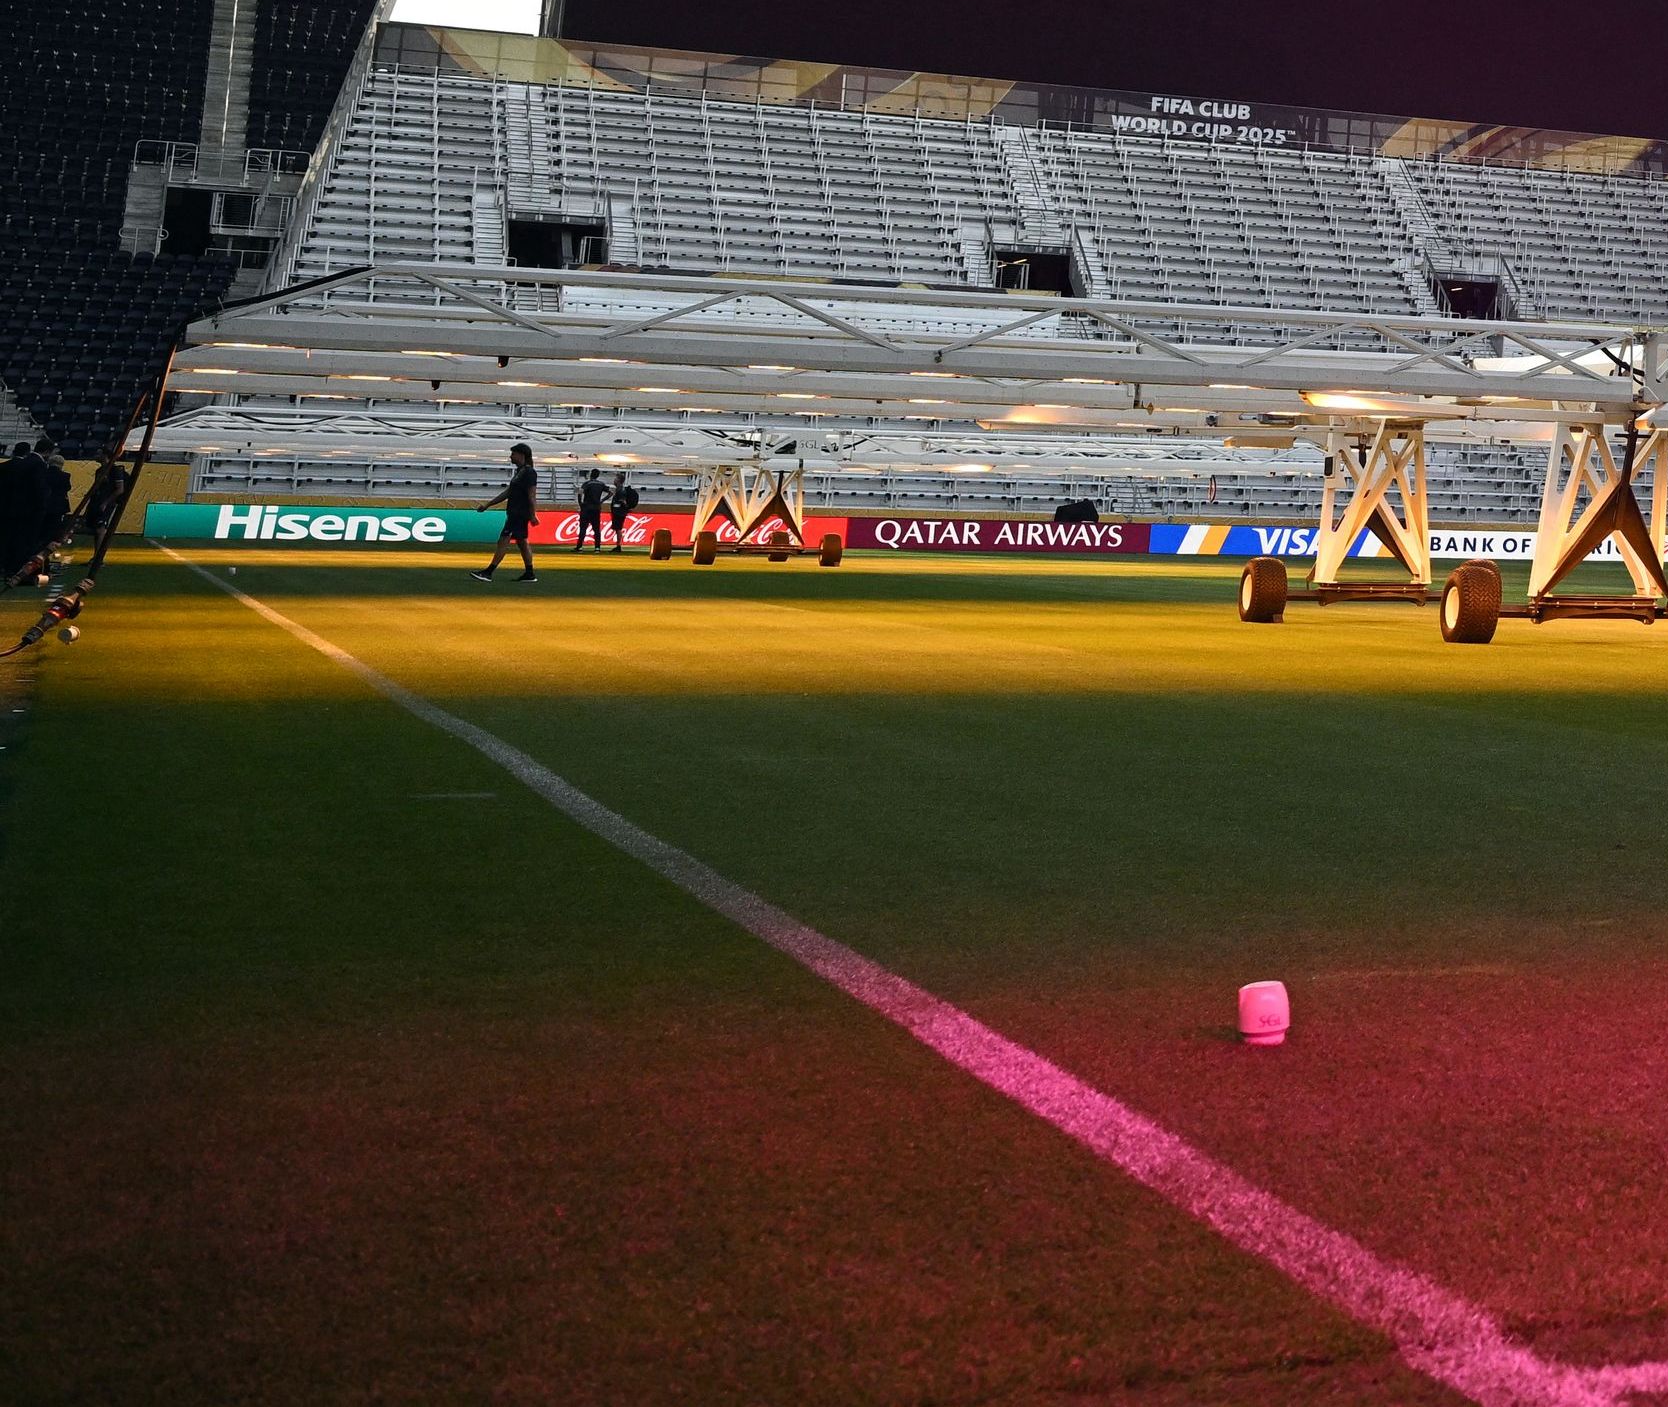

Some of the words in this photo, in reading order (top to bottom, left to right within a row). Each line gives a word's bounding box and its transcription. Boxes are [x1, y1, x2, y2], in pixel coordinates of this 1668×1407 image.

[1151, 96, 1195, 116] FIFA
[1199, 101, 1251, 120] CLUB
[1111, 114, 1187, 136] WORLD
[1191, 122, 1233, 139] CUP
[214, 504, 447, 542] Hisense
[875, 519, 981, 549] QATAR
[994, 522, 1123, 548] AIRWAYS
[1430, 536, 1494, 553] BANK
[1502, 537, 1532, 554] OF
